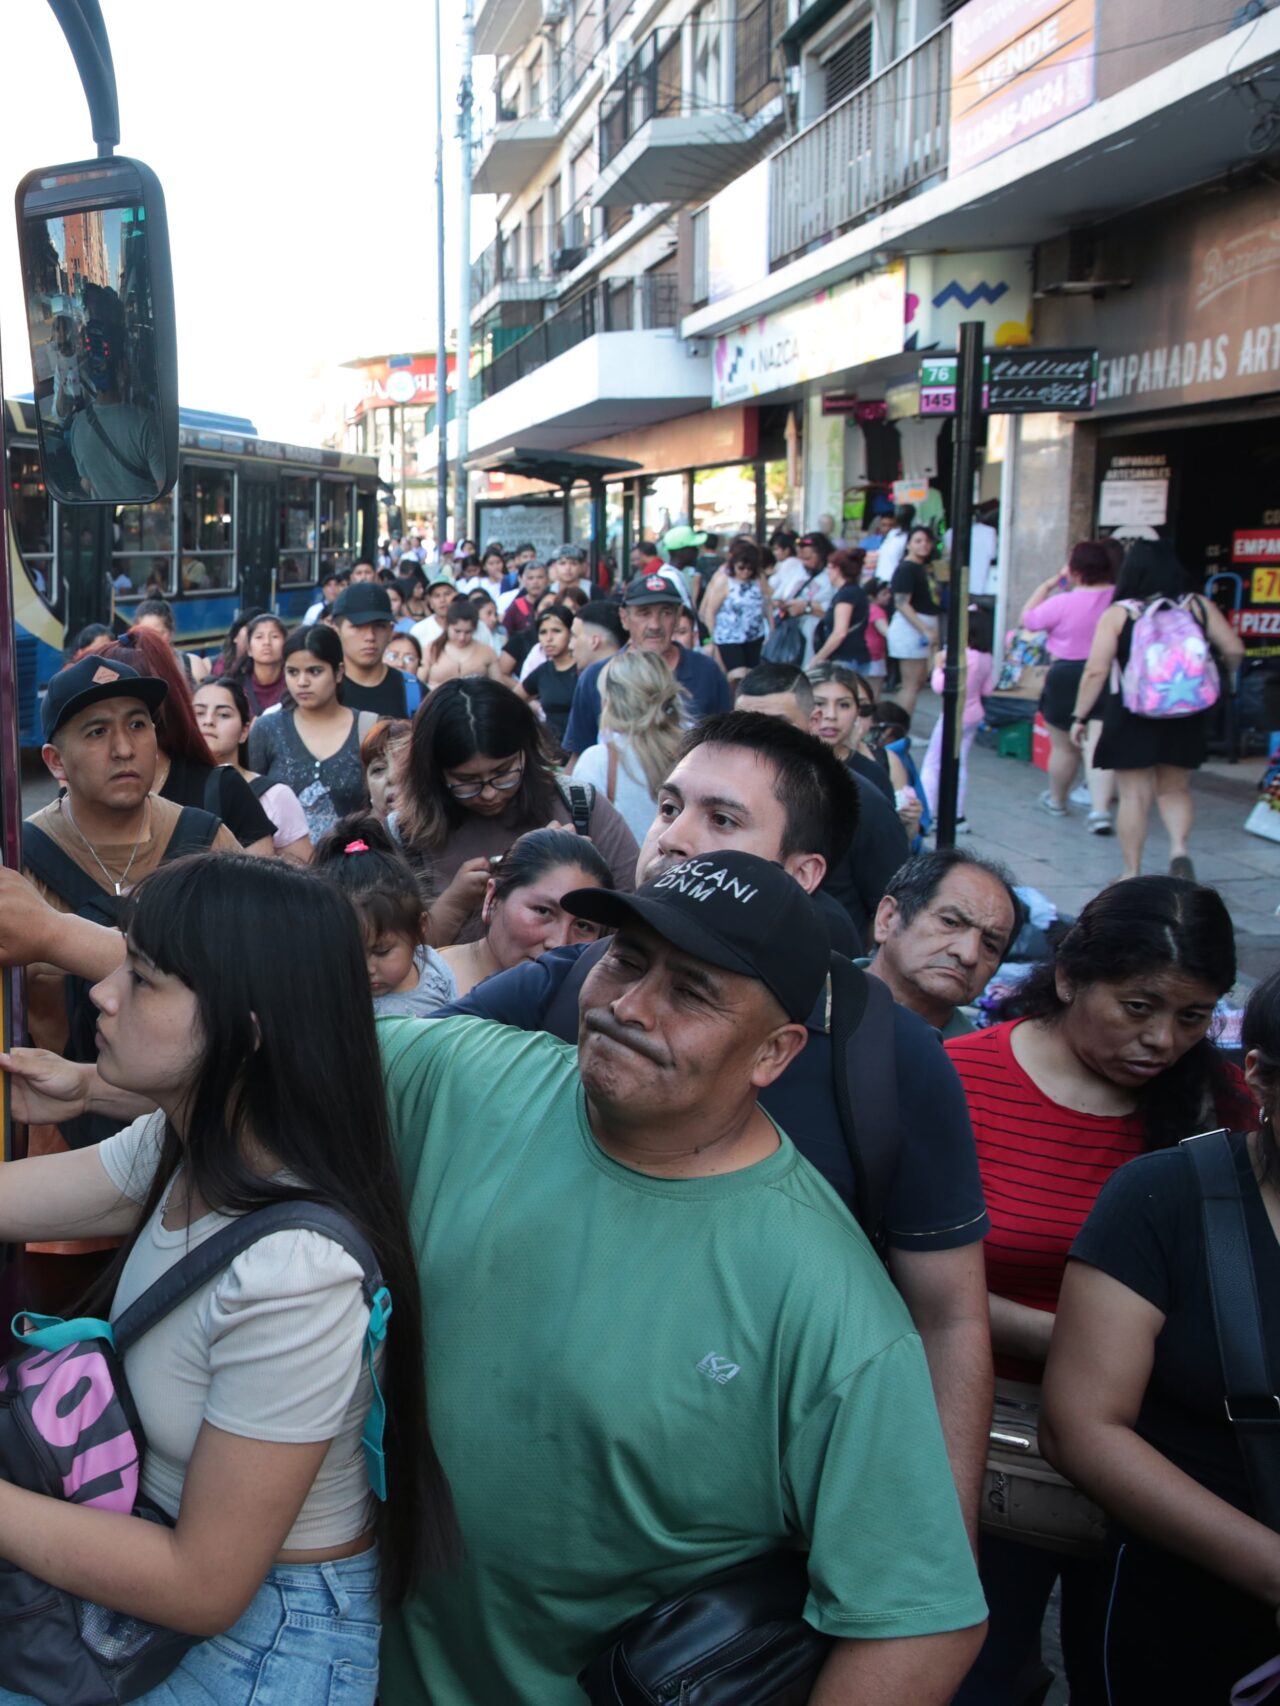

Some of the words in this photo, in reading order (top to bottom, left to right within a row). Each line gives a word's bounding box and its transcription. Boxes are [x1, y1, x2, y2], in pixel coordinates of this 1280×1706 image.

[976, 18, 1060, 93] VENDE
[758, 336, 800, 374] NAZCA
[1097, 333, 1230, 401] EMPANADAS
[928, 367, 950, 382] 76
[923, 394, 952, 407] 145
[653, 874, 716, 902] DNM
